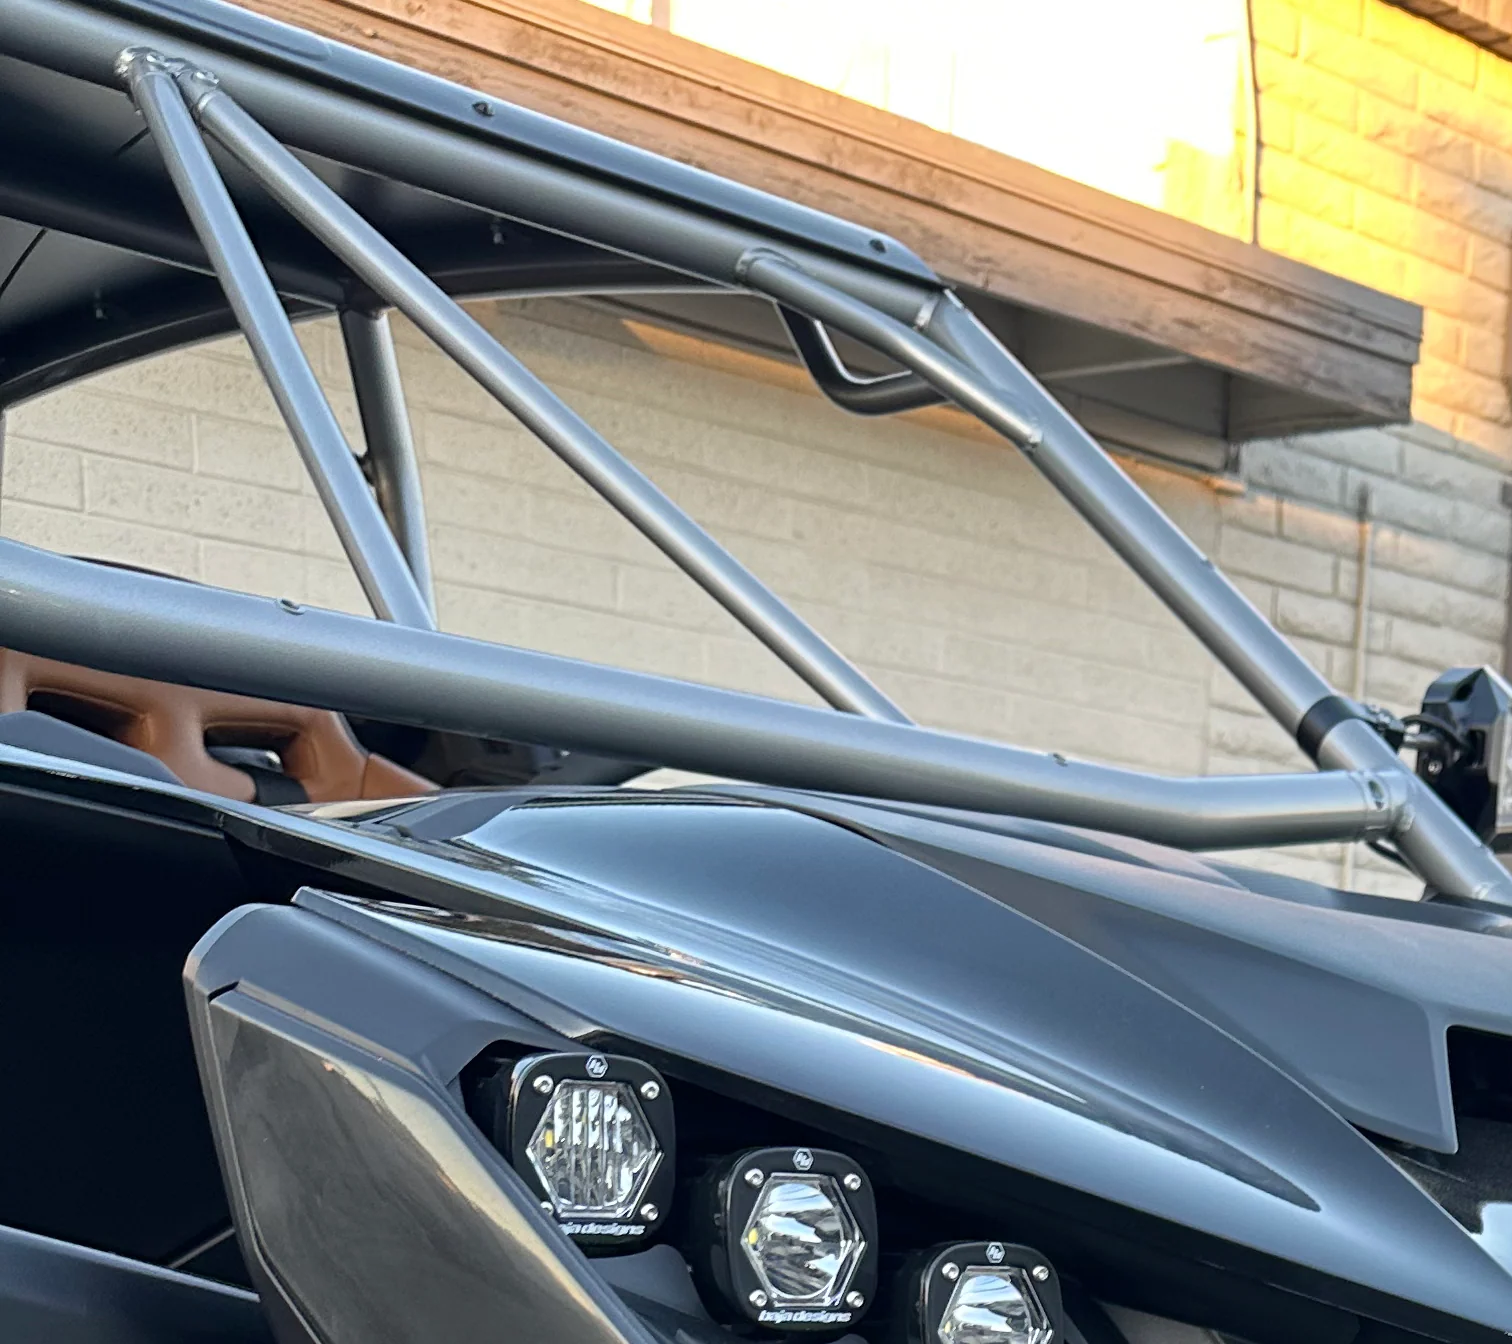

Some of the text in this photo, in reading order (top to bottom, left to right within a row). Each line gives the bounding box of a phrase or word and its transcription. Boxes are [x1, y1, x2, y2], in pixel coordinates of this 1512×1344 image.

[581, 1222, 646, 1236] designs
[758, 1309, 852, 1323] baja designs
